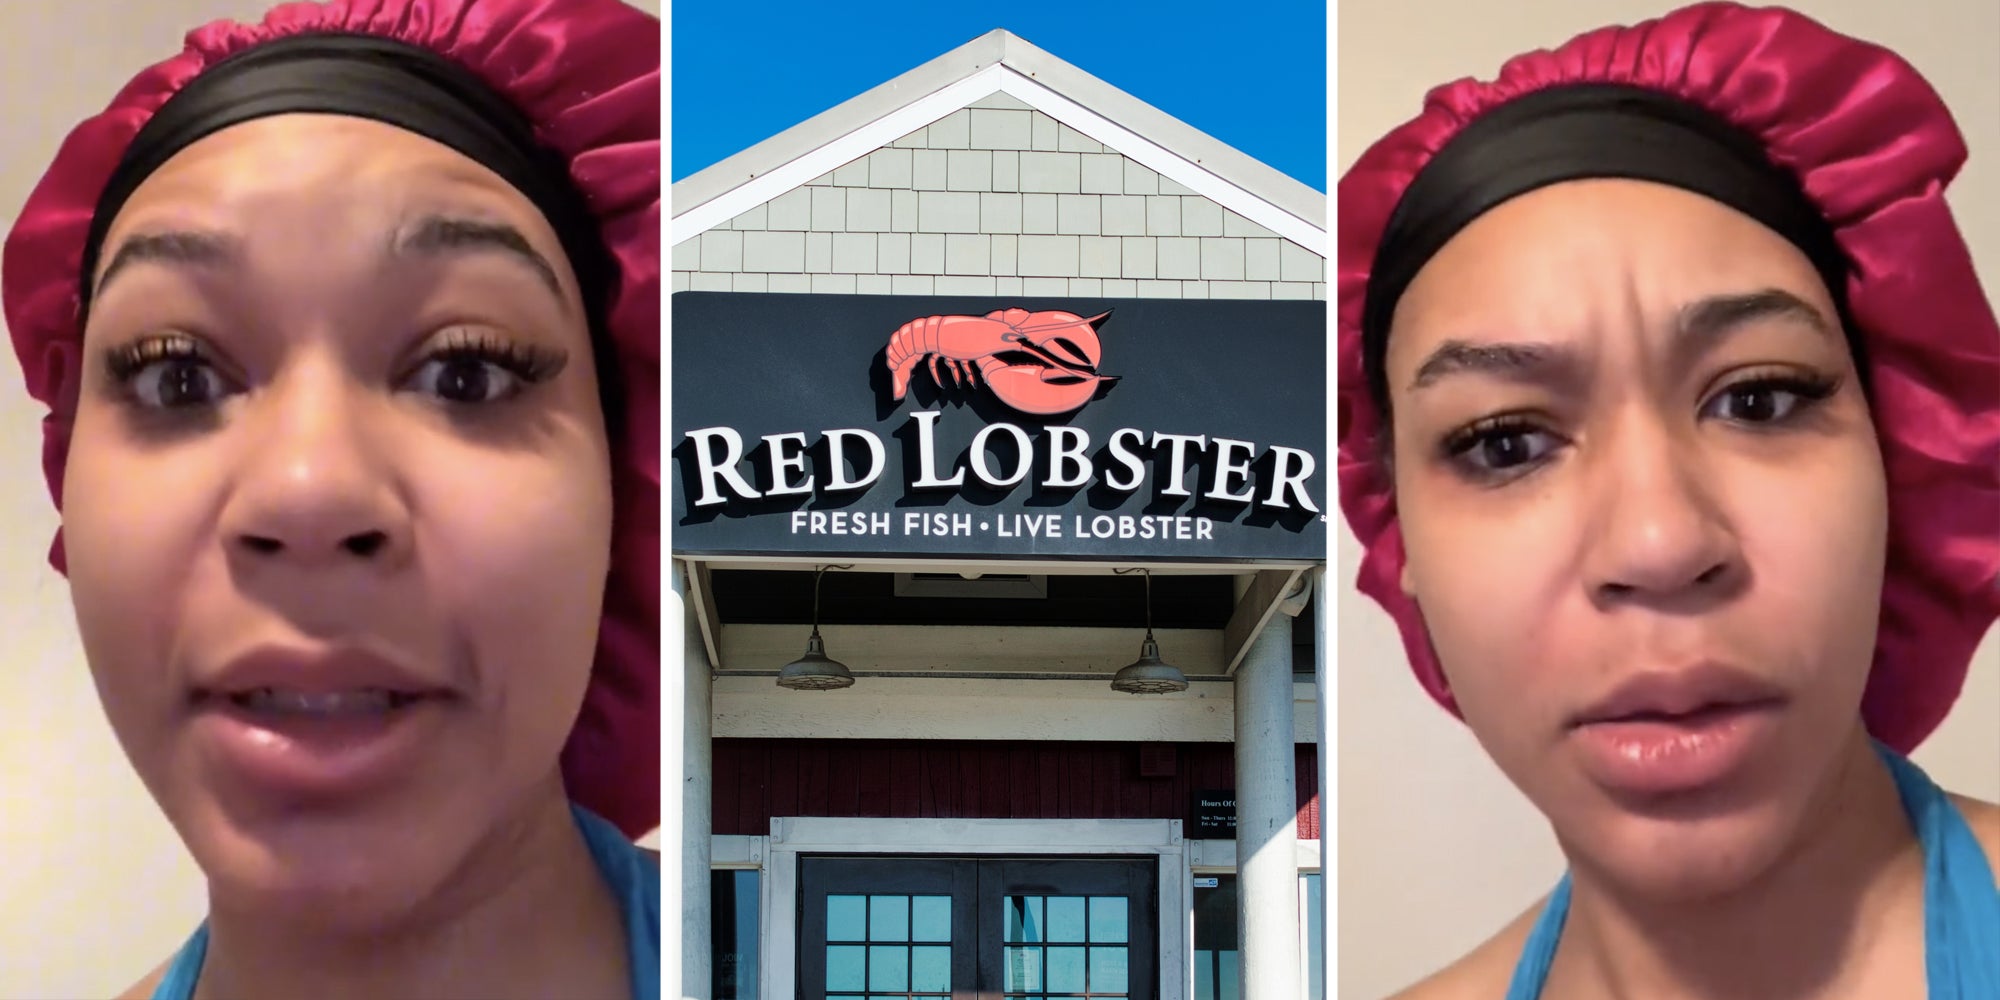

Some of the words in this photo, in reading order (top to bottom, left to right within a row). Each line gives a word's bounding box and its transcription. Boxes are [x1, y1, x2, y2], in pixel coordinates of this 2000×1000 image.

[684, 426, 886, 506] RED
[909, 410, 1320, 513] LOBSTER
[791, 510, 890, 536] FRESH
[904, 512, 972, 537] FISH
[997, 513, 1062, 539] LIVE
[1075, 515, 1213, 540] LOBSTER
